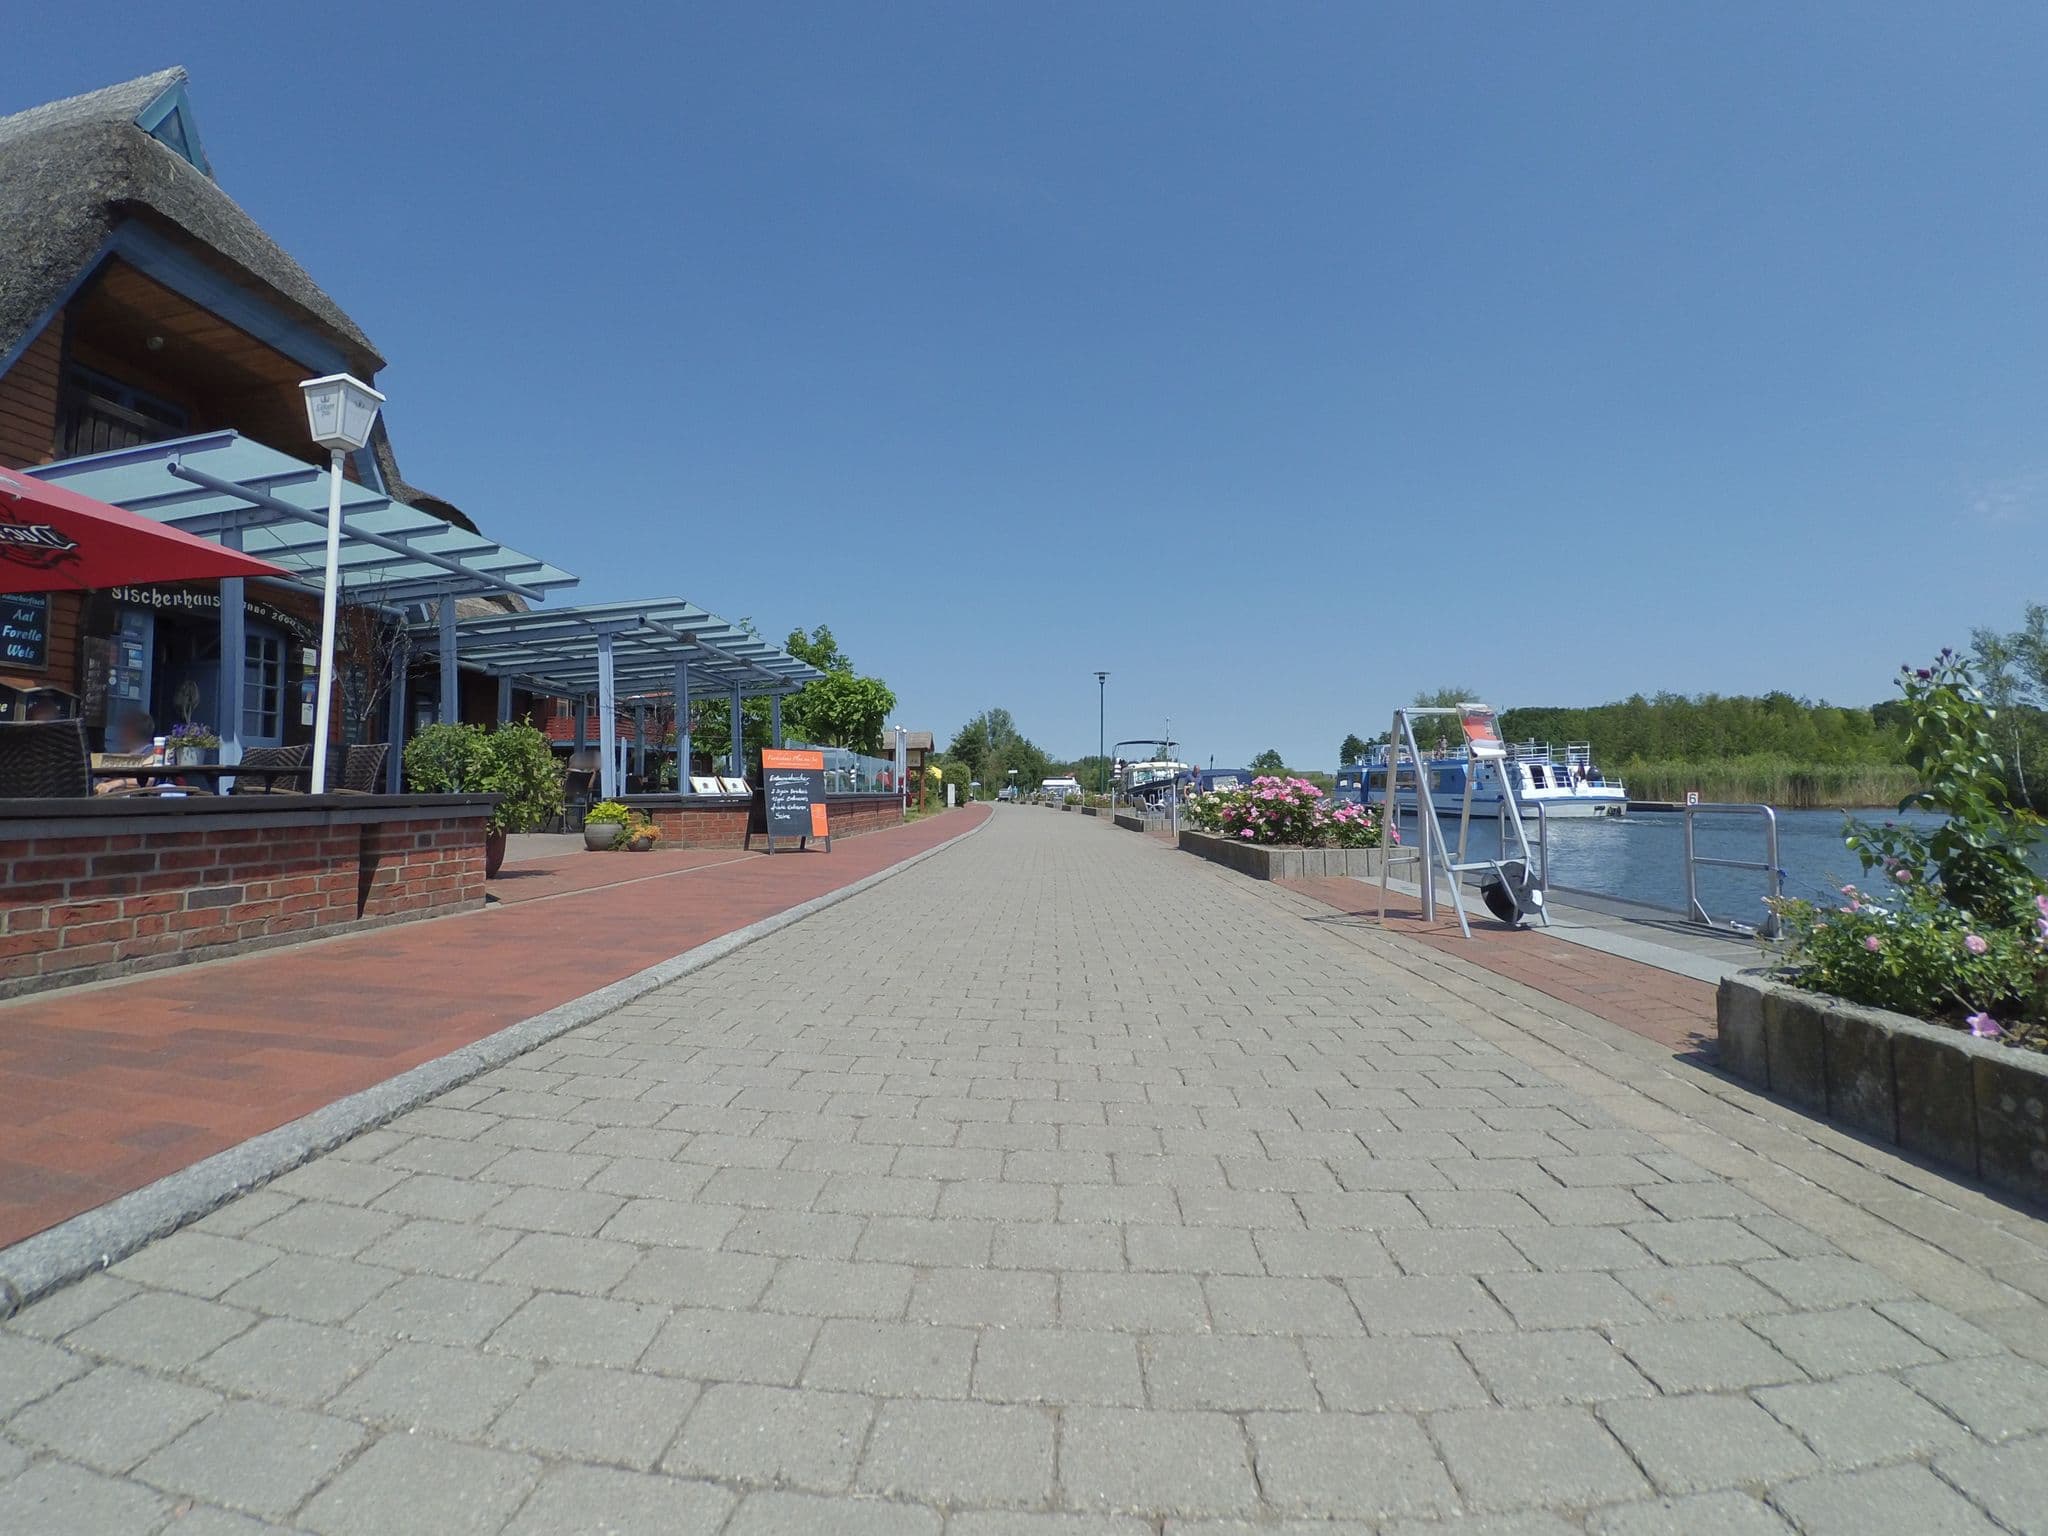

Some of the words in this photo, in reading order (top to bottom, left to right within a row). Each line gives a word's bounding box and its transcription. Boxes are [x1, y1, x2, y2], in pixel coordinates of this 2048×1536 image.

[12, 608, 35, 622] Aal
[2, 625, 42, 641] Forelle
[7, 643, 35, 658] Wels
[1689, 793, 1697, 804] 6
